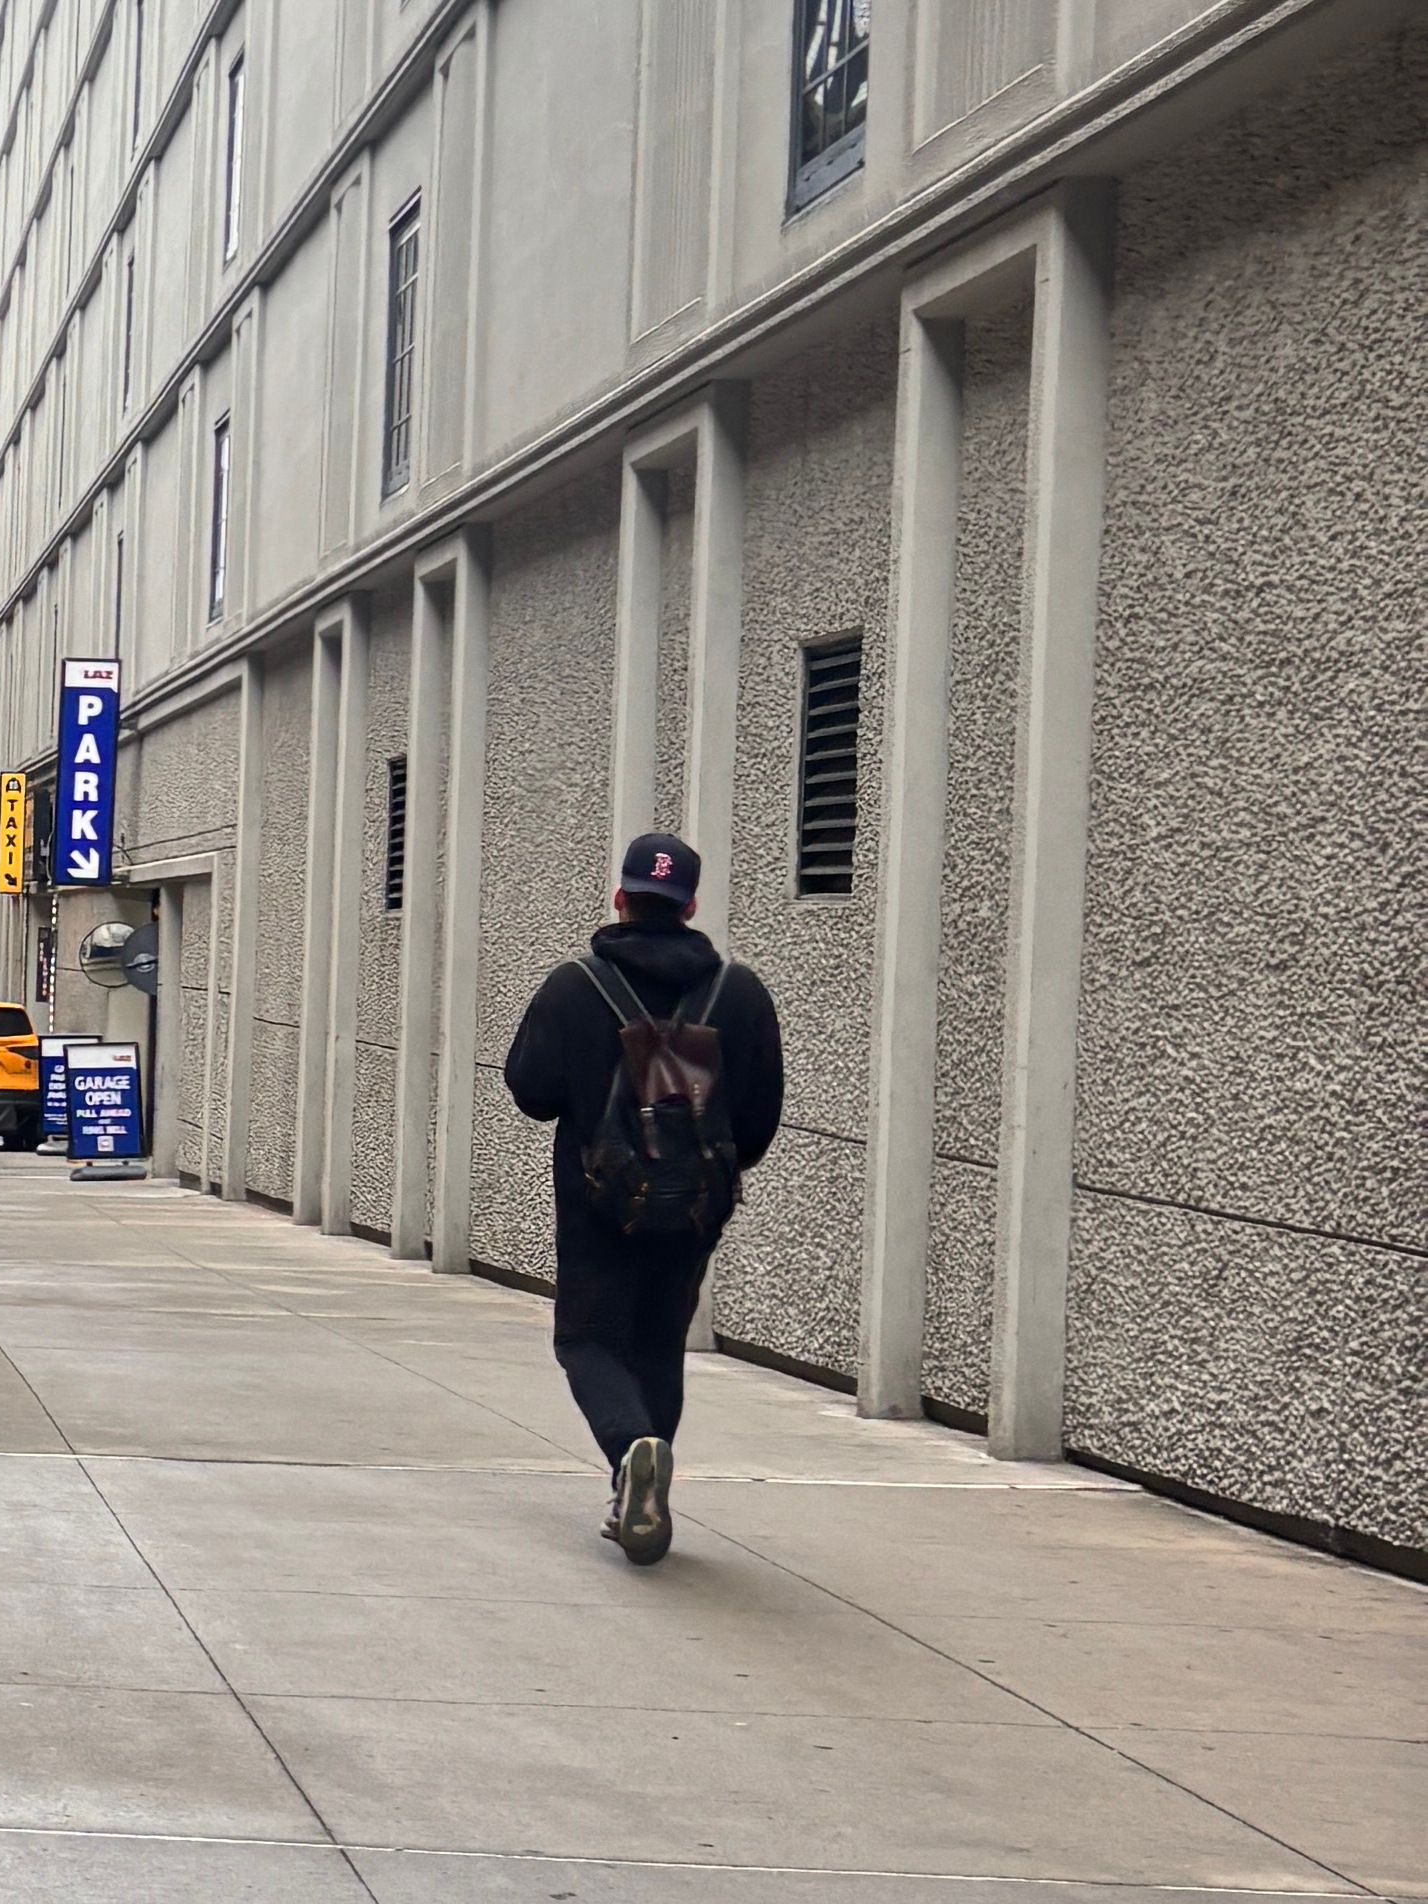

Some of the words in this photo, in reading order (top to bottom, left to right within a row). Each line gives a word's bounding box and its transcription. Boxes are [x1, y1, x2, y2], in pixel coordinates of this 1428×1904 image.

[71, 695, 103, 841] PARK
[4, 800, 18, 864] TAXI
[74, 1076, 130, 1090] GARAGE
[85, 1091, 121, 1105] OPEN
